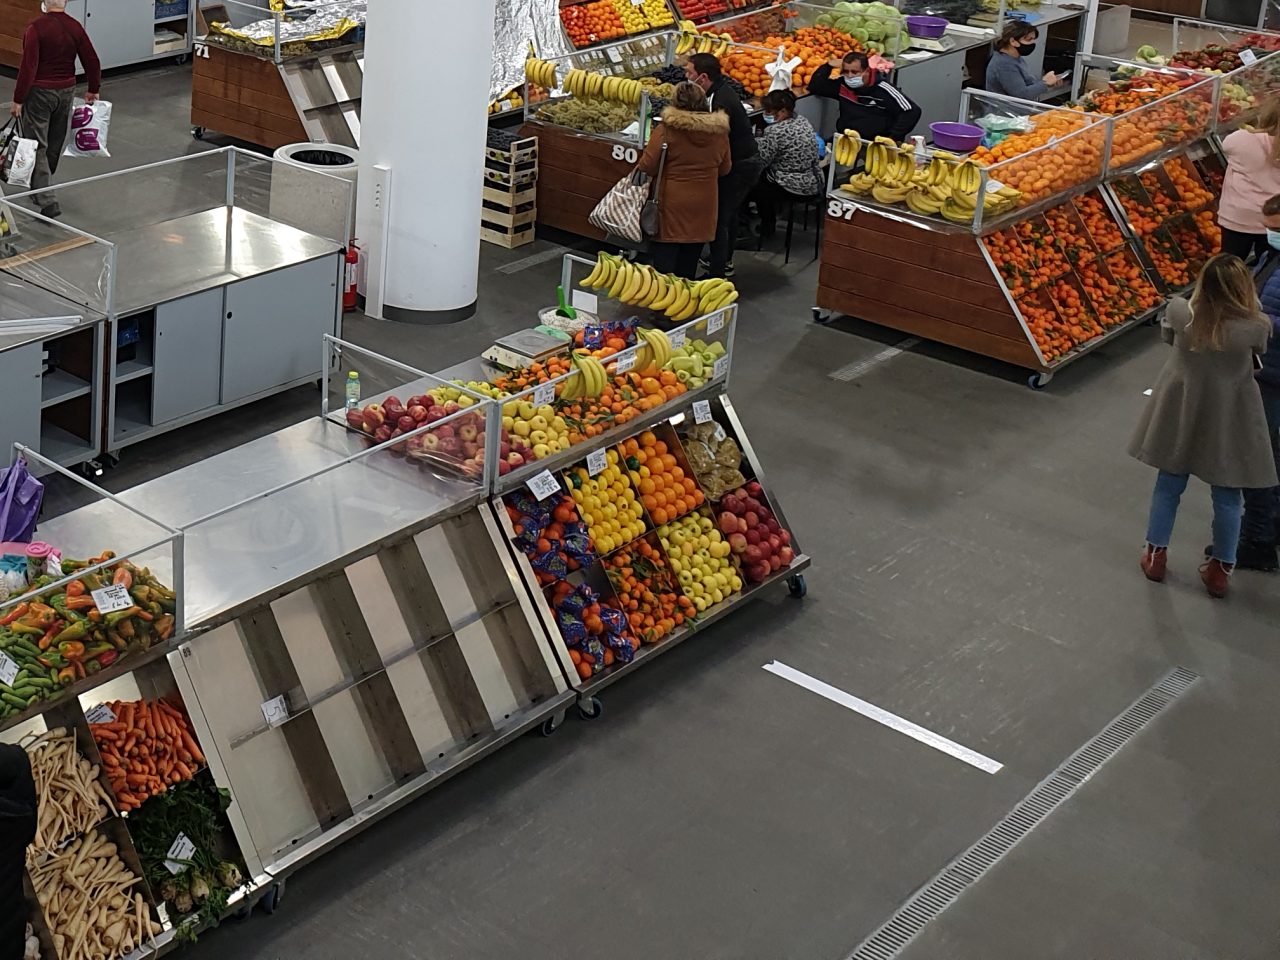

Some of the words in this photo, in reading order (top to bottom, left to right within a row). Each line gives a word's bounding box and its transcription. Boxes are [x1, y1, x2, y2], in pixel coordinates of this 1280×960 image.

[194, 44, 209, 59] 71
[611, 144, 638, 164] 80
[827, 200, 856, 221] 87
